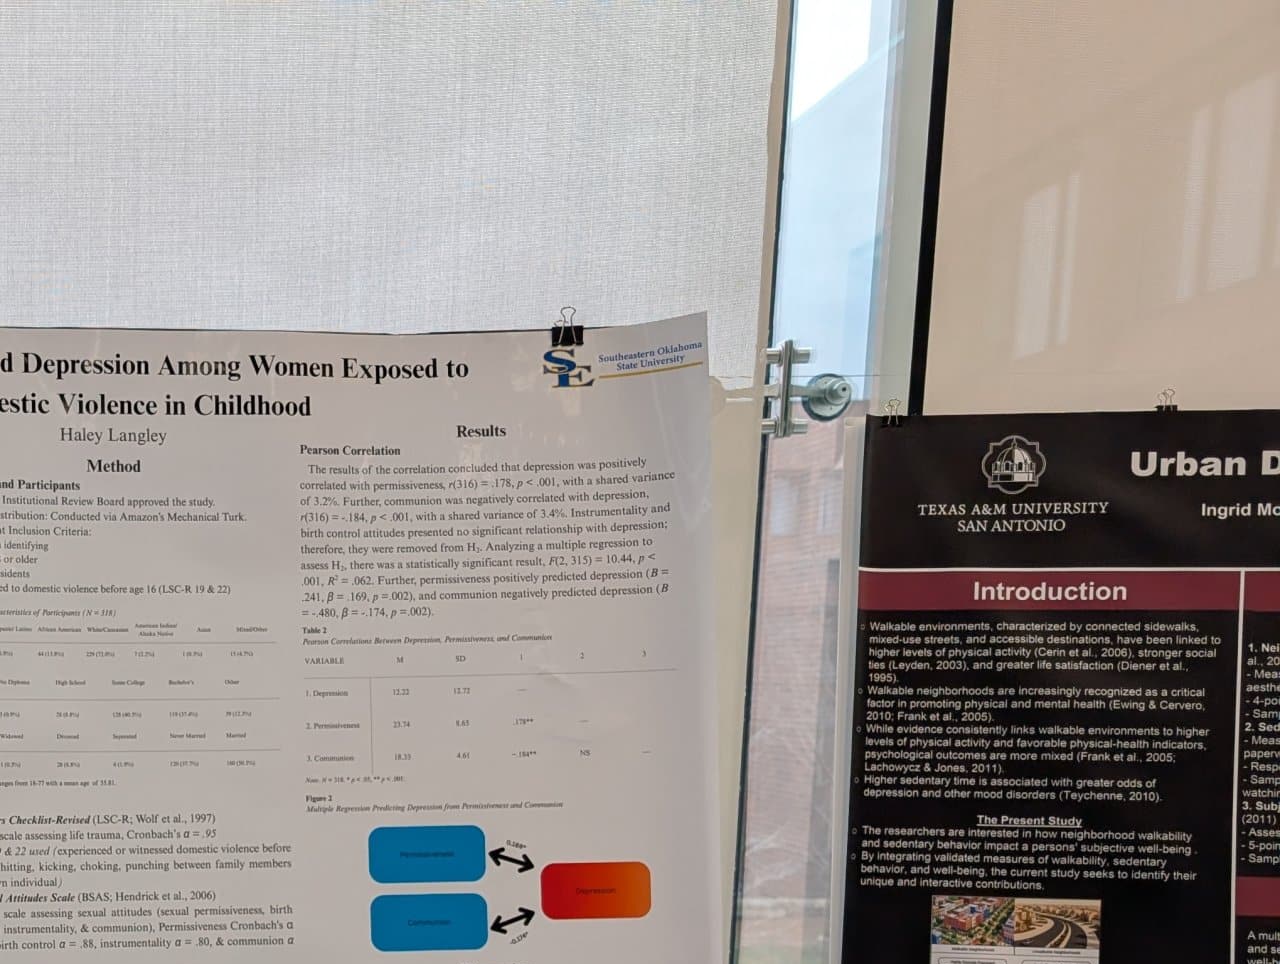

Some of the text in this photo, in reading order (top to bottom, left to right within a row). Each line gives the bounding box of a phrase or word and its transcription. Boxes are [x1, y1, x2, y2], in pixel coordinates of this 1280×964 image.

[598, 342, 703, 363] Southeastern Oklahoma
[22, 352, 149, 377] Depression
[157, 355, 241, 381] Among
[248, 354, 334, 378] Women
[342, 357, 438, 385] Exposed
[445, 359, 469, 378] to
[616, 355, 686, 373] State University
[58, 392, 158, 416] Violence
[166, 394, 186, 416] in
[194, 394, 312, 416] Childhood
[59, 427, 167, 447] Haley Langley
[457, 424, 507, 438] Results
[299, 444, 401, 456] Pearson Correlation
[86, 458, 141, 473] Method
[1131, 450, 1247, 477] Urban
[17, 479, 81, 493] Participants
[917, 501, 1110, 516] TEXAS A&M UNIVERSITY
[1201, 502, 1252, 520] Ingrid
[8, 525, 51, 536] Inclusion
[956, 518, 1066, 533] SAN ANTONIO
[3, 540, 49, 553] identifying
[14, 554, 38, 564] older
[973, 581, 1127, 601] Introduction
[864, 763, 920, 775] Lachowycz
[9, 815, 90, 825] Checklist-Revised
[136, 813, 159, 825] Wolf
[190, 813, 216, 824] 1997)
[976, 814, 1083, 828] The Present Study
[859, 877, 895, 888] unique
[896, 877, 917, 887] and
[919, 878, 973, 889] interactive
